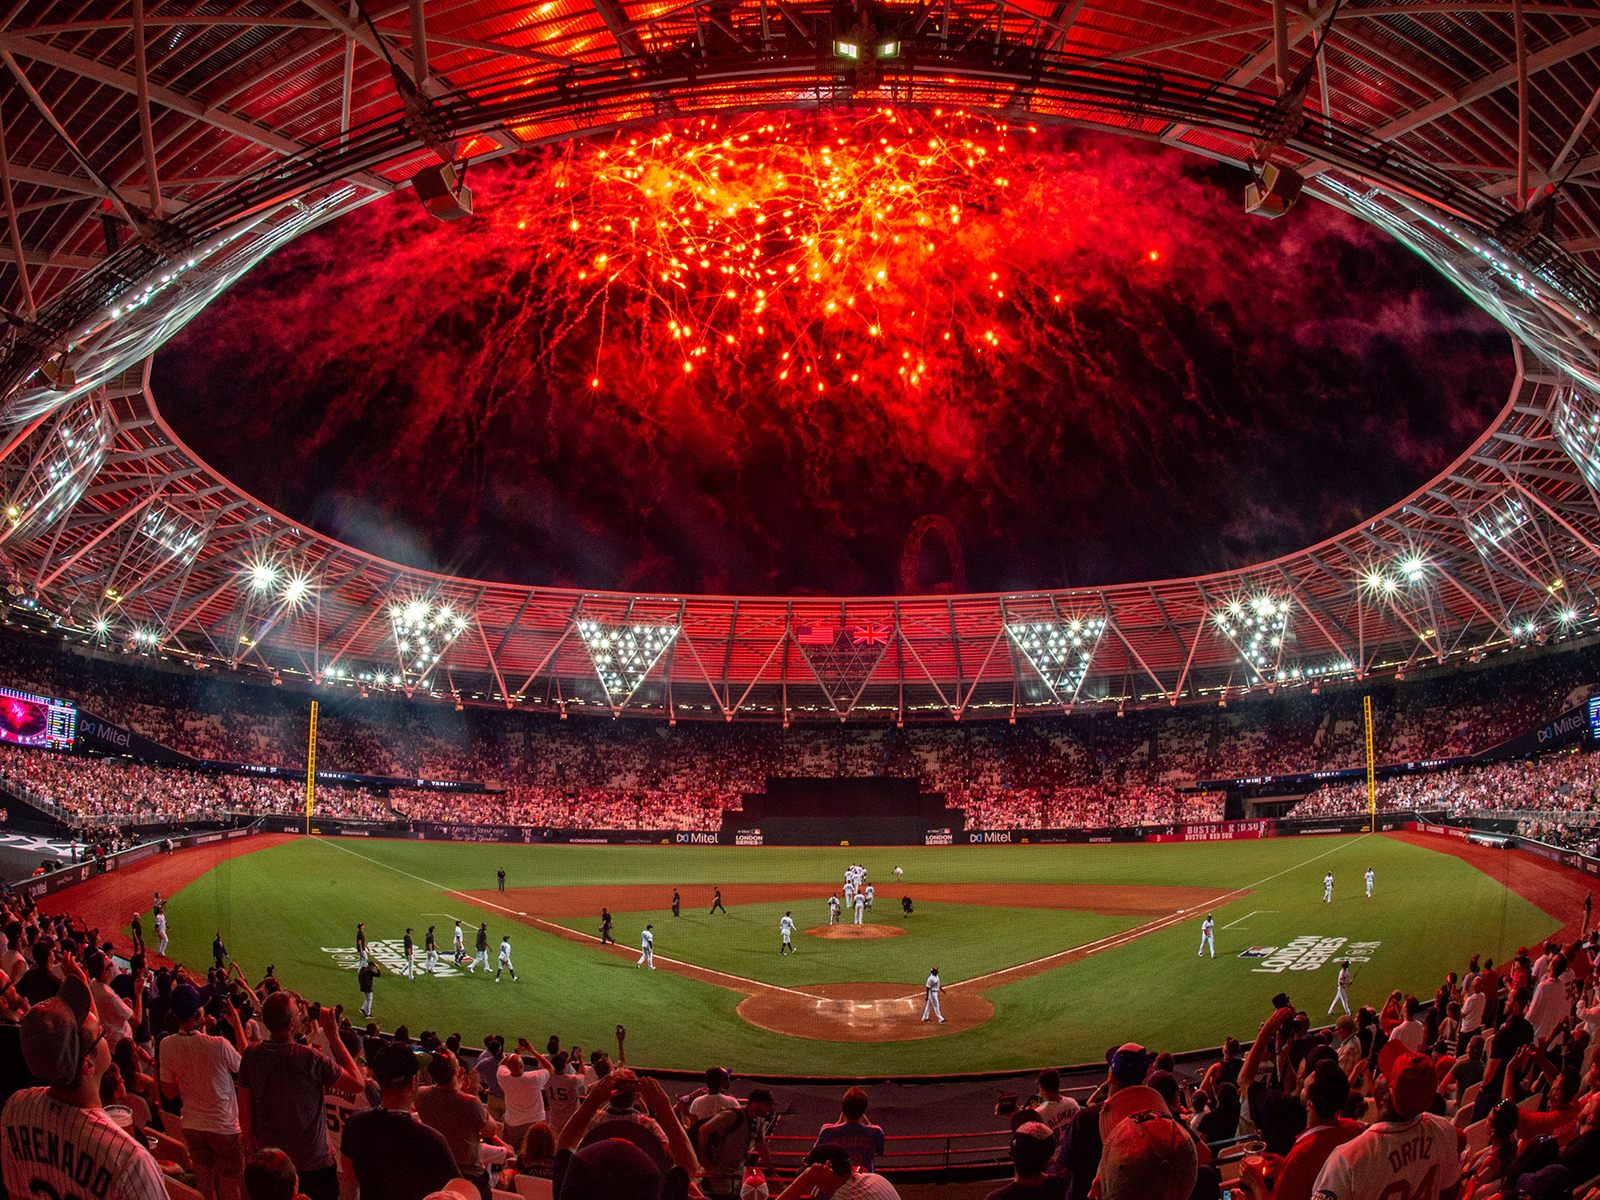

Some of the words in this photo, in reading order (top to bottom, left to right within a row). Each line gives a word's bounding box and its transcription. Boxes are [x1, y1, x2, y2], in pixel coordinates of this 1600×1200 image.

[97, 723, 131, 748] Mitel
[1553, 710, 1586, 736] Mitel
[690, 832, 718, 844] Mitel
[984, 831, 1012, 843] Mitel
[1221, 832, 1233, 840] SOX
[1251, 935, 1323, 973] LONDON
[1288, 936, 1348, 971] SERIES
[549, 1086, 568, 1101] 15
[7, 1125, 112, 1200] ARENADO
[1388, 1136, 1433, 1173] ORTIZ
